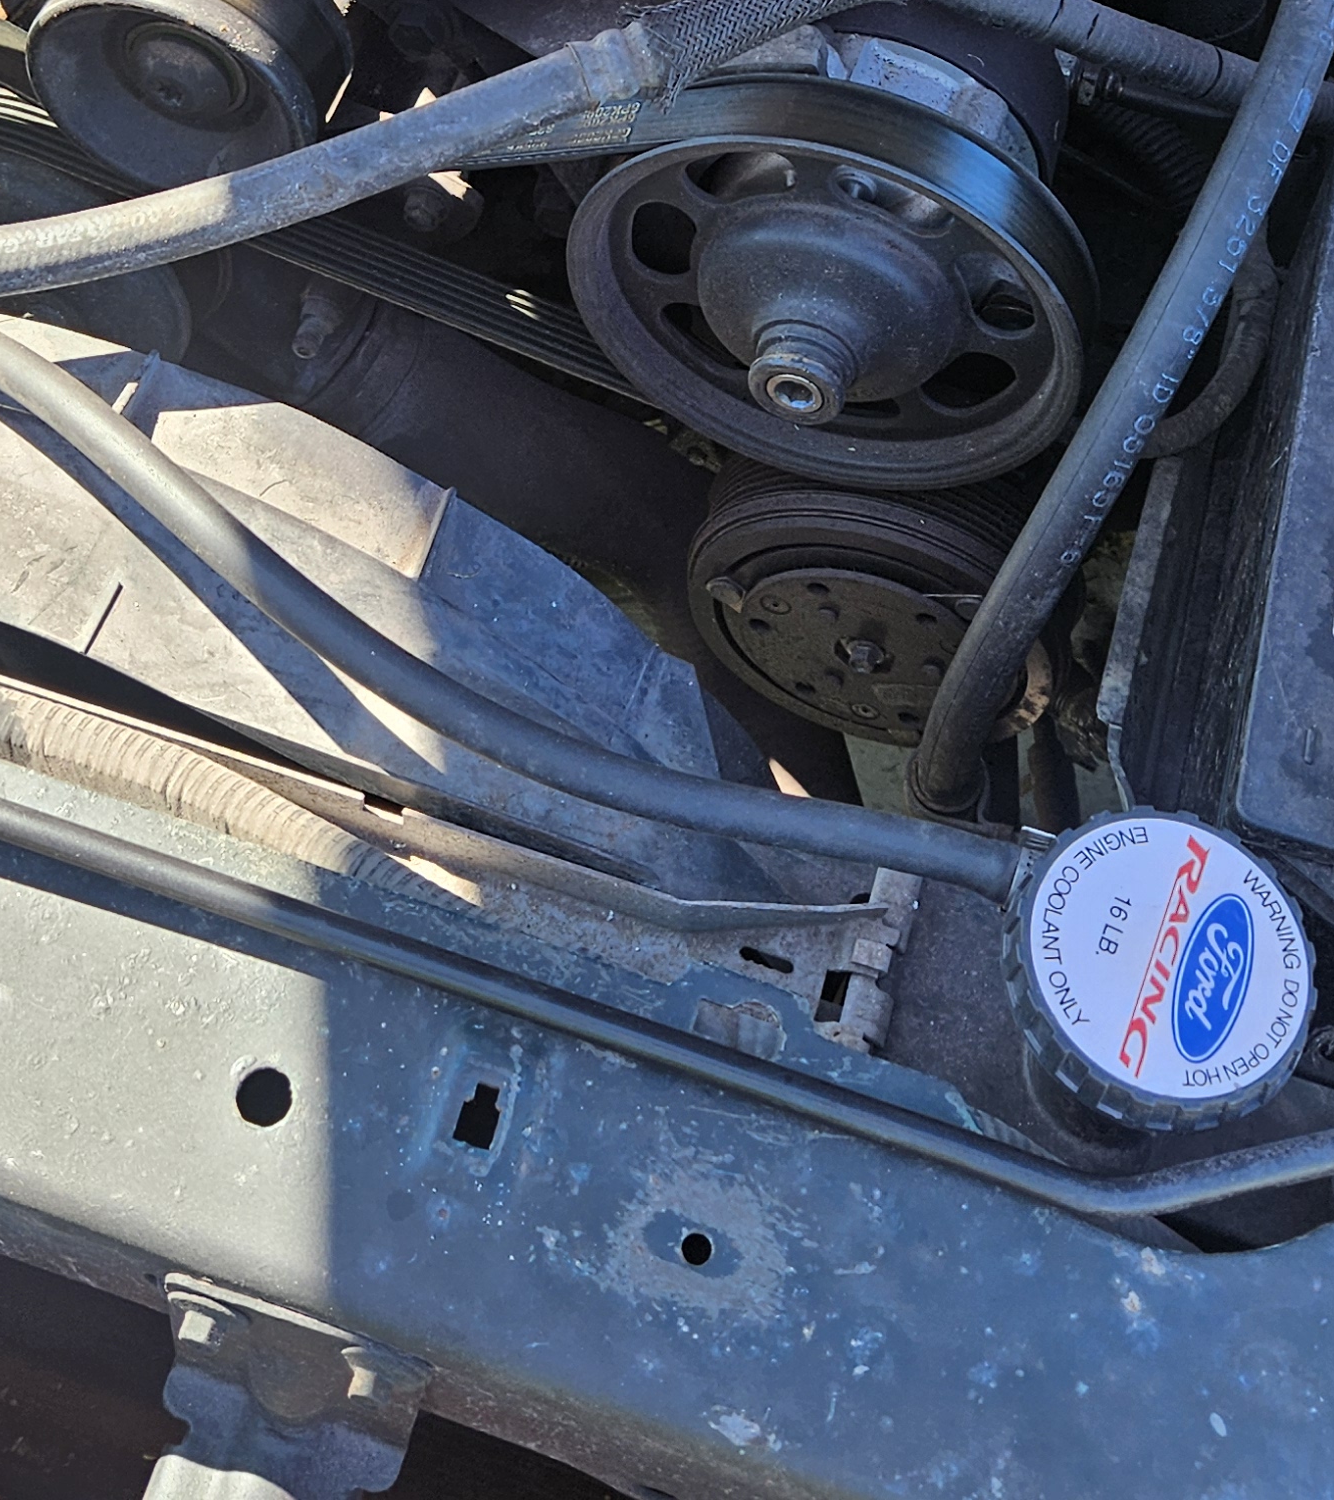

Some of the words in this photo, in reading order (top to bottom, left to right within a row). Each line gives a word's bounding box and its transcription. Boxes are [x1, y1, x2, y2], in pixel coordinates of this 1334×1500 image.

[1074, 825, 1149, 870] ENGINE
[1041, 864, 1081, 965] COOLANT
[1108, 893, 1132, 922] 16
[1243, 869, 1302, 970] WARNING
[1119, 834, 1211, 1079] RACING
[1183, 921, 1245, 1031] Ford
[1048, 970, 1091, 1027] ONLY
[1280, 979, 1301, 1007] DO
[1265, 1010, 1295, 1050] NOT
[1182, 1063, 1223, 1088] HOT
[1226, 1041, 1271, 1078] OPEN
